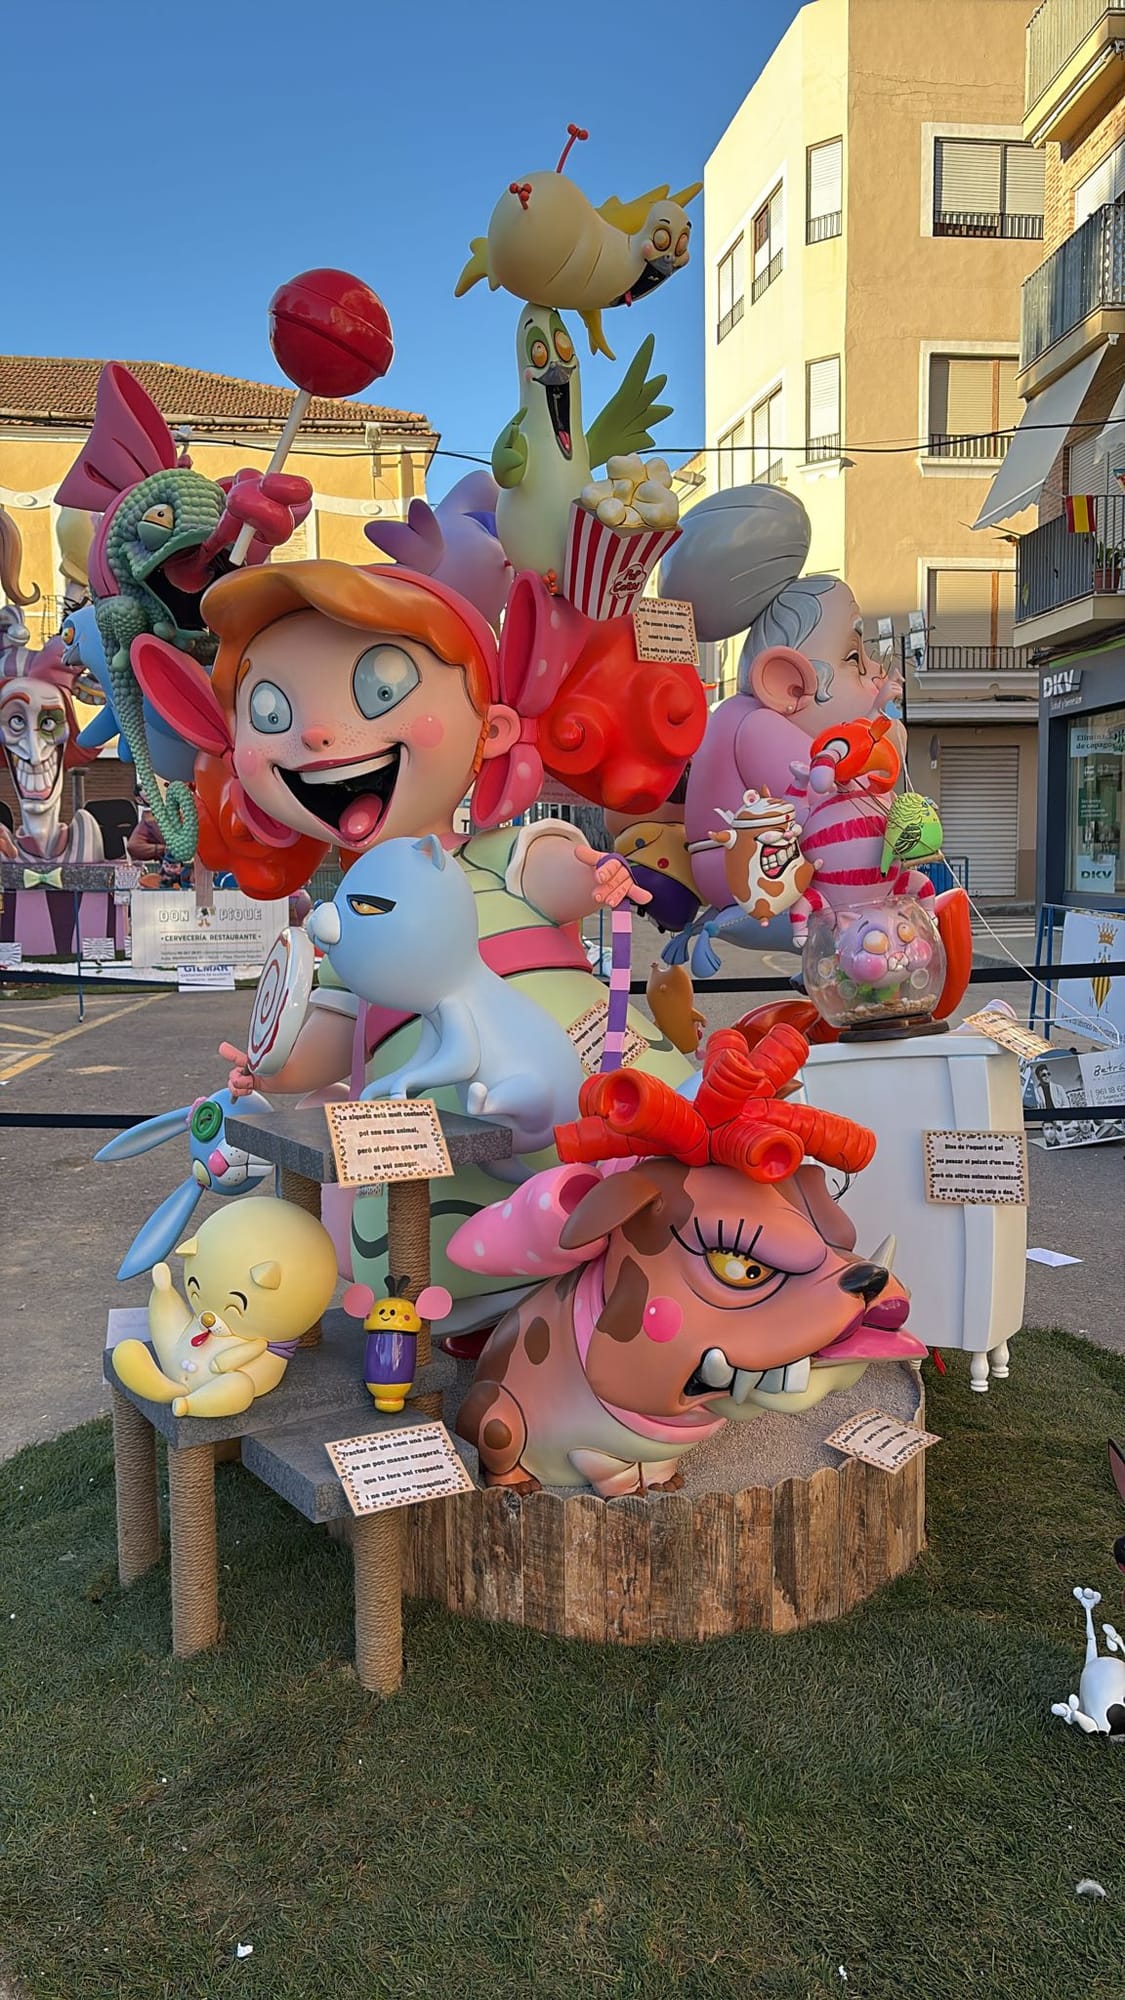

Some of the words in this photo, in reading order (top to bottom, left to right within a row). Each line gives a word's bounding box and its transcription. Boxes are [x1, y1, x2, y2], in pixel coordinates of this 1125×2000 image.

[1043, 670, 1074, 698] DKV
[1081, 870, 1112, 879] DKV
[159, 910, 190, 922] DON
[165, 932, 206, 942] CERVECERÍA
[210, 933, 256, 941] RESTAURANTE
[381, 1145, 399, 1153] pobre
[342, 1448, 366, 1458] Tractar
[372, 1460, 386, 1468] poc
[387, 1456, 409, 1464] massa
[411, 1450, 443, 1460] exagerat,
[386, 1472, 400, 1480] fera
[415, 1464, 444, 1475] respecte
